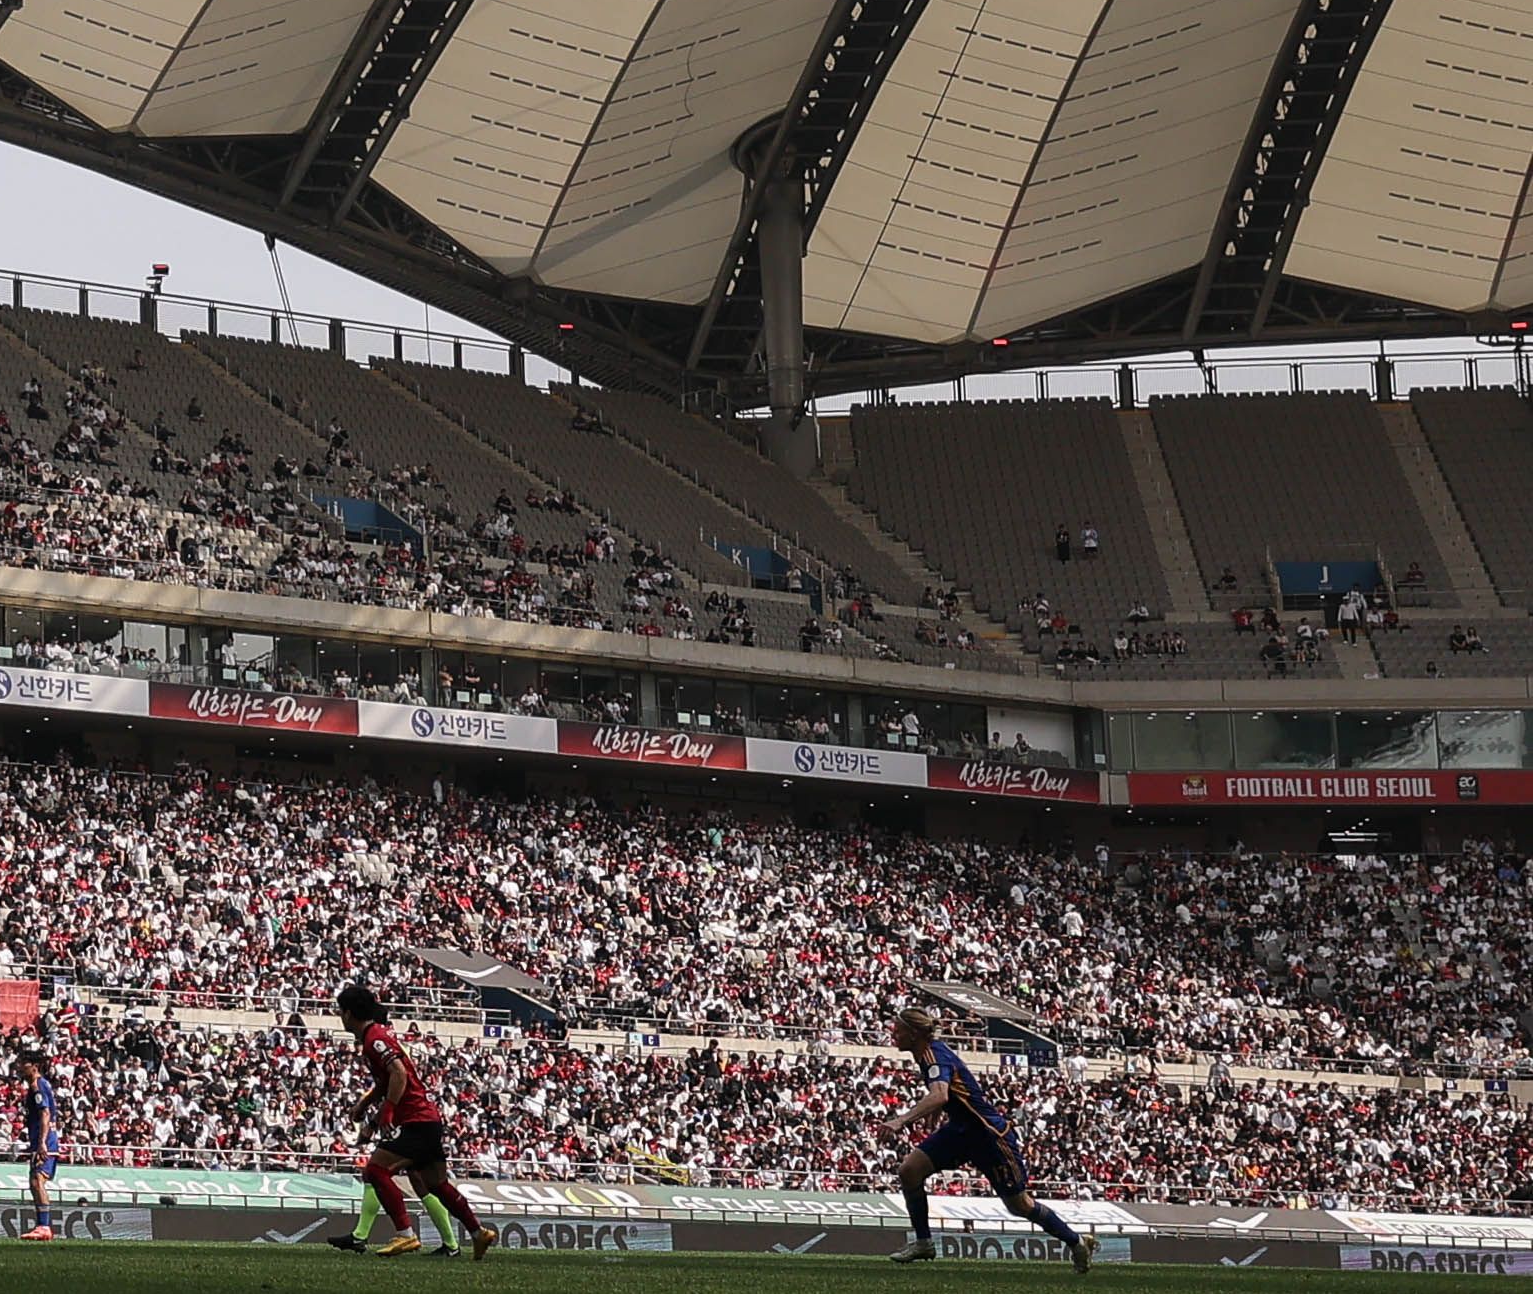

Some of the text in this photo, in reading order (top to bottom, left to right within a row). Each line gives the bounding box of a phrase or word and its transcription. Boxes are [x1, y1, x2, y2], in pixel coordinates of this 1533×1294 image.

[17, 674, 93, 703] 신한카드
[269, 694, 323, 732] Day
[437, 714, 508, 741] 신한카드
[665, 731, 715, 766] Day
[818, 749, 882, 776] 신한카드
[1025, 767, 1071, 799] Day
[1226, 777, 1436, 798] FOOTBALL CLUB SEOUL
